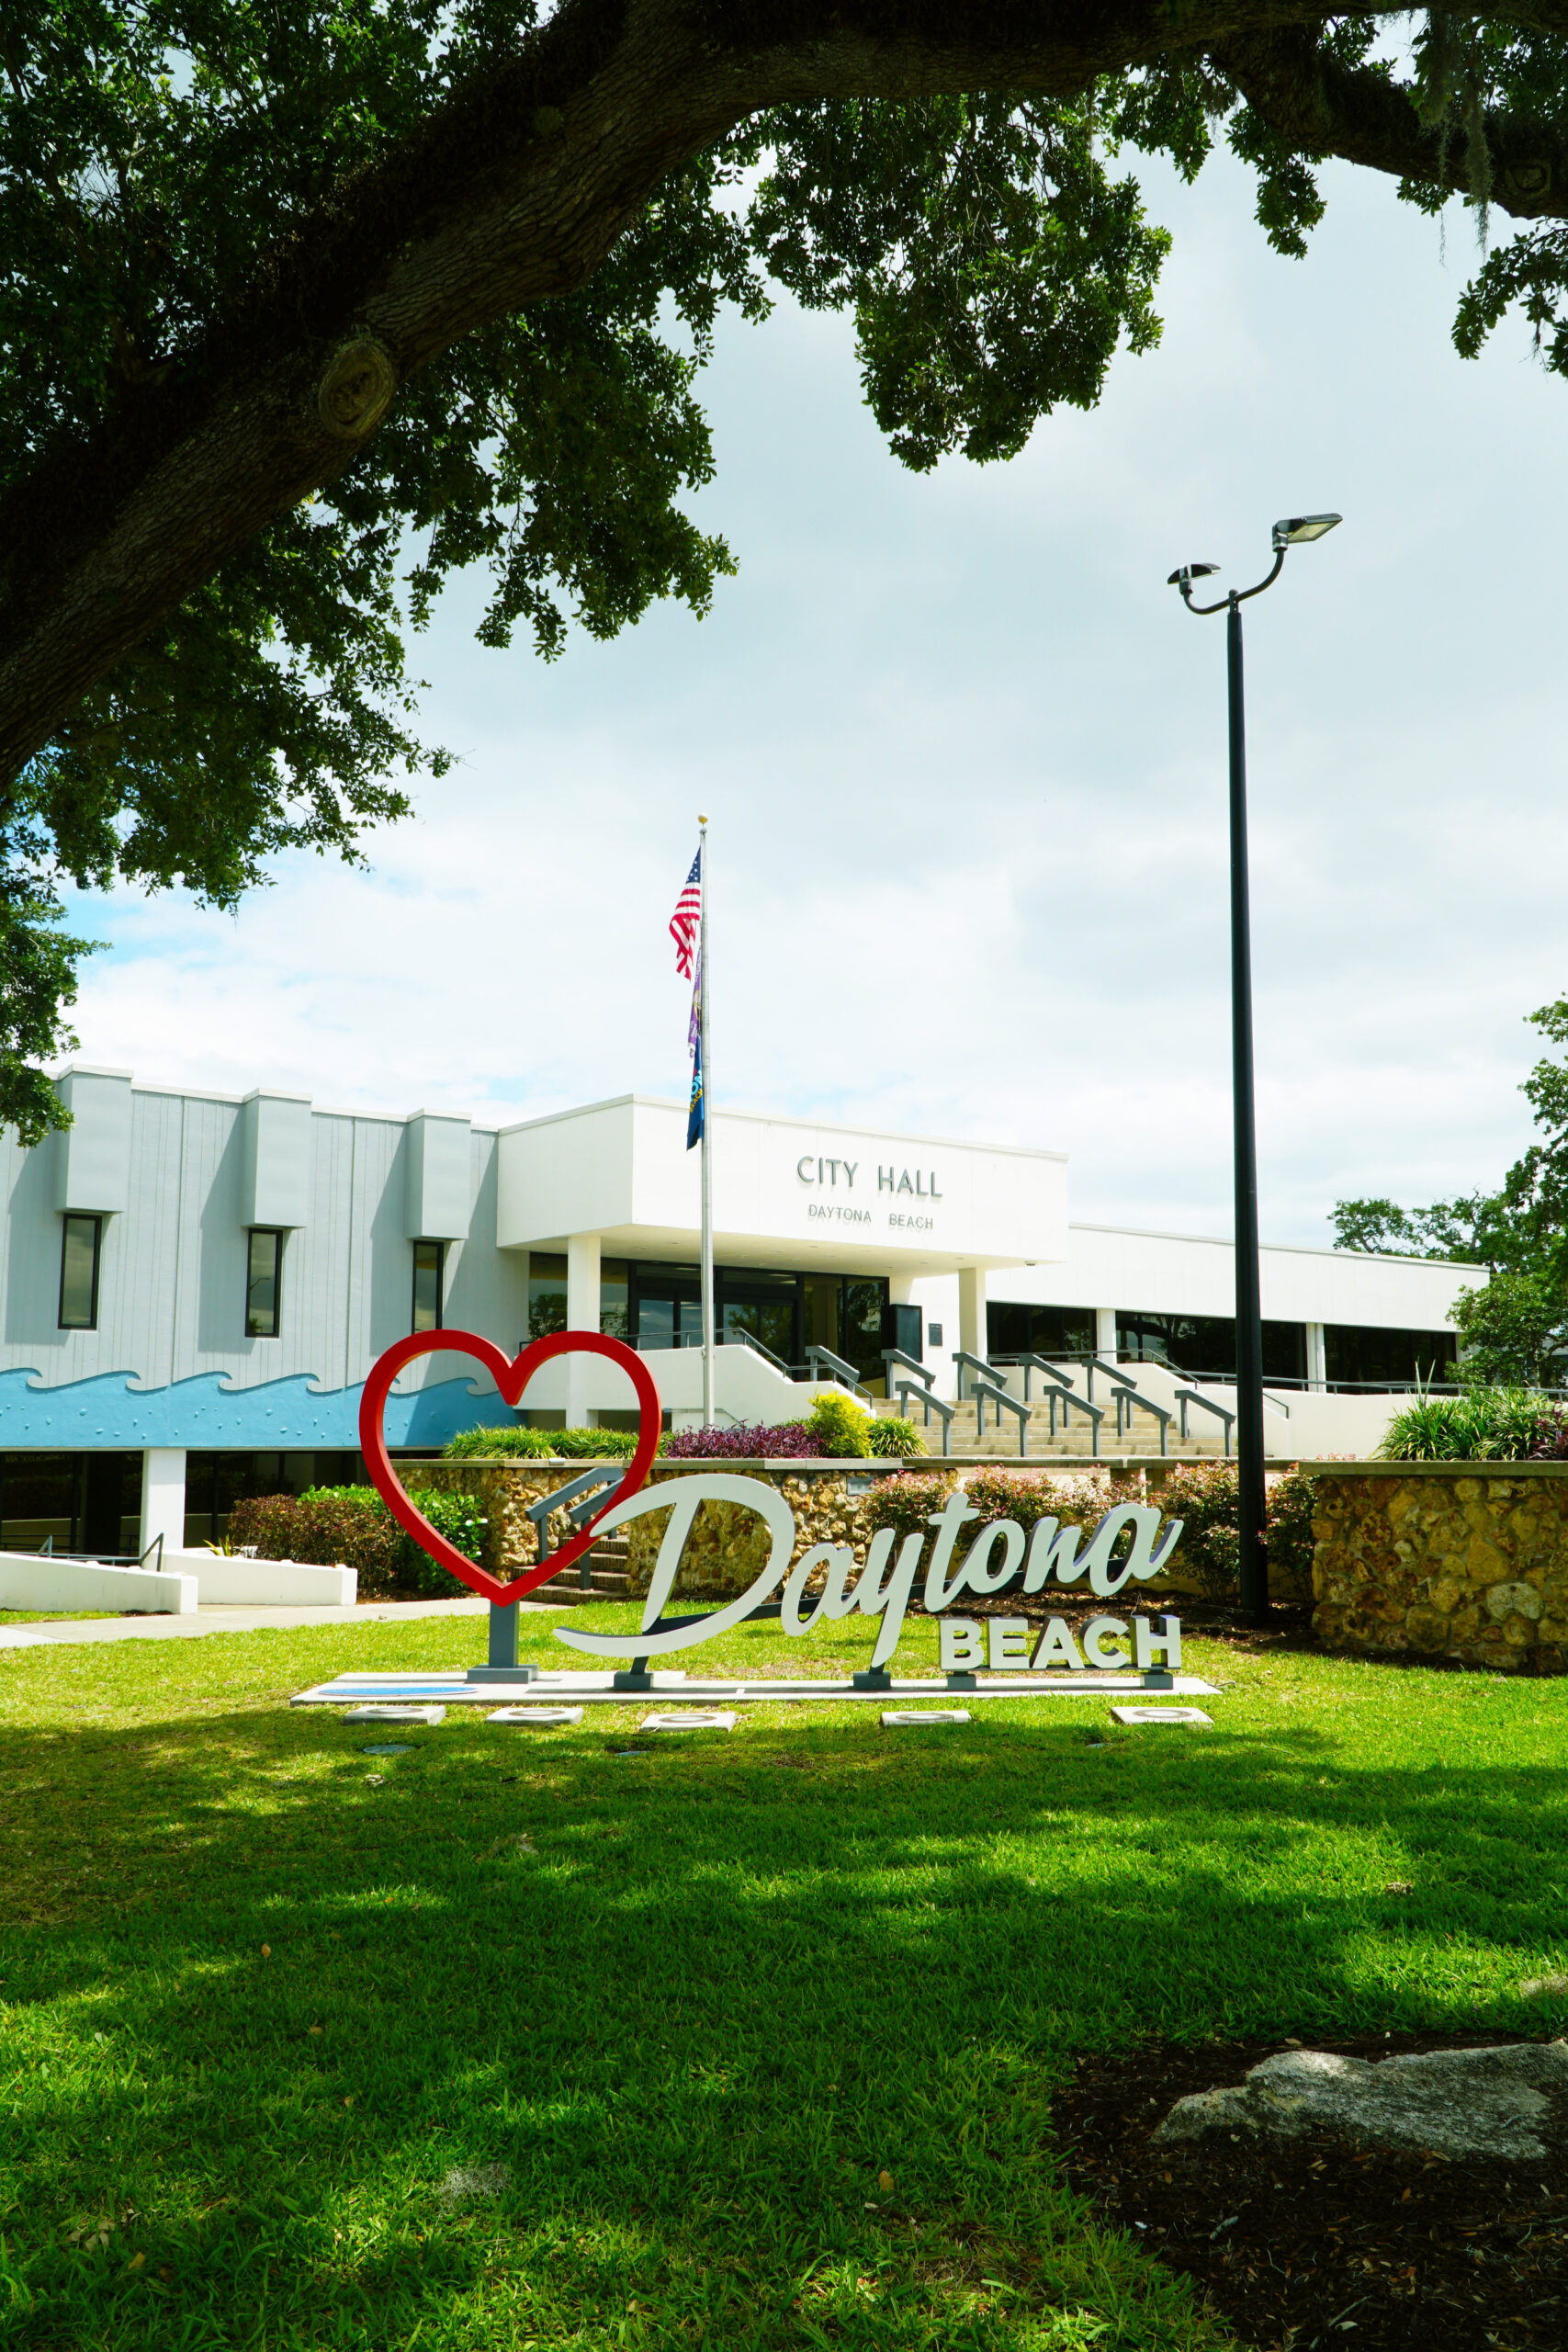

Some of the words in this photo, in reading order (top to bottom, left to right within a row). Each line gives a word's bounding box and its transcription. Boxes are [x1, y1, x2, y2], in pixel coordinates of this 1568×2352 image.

[797, 1156, 859, 1188] CITY
[878, 1166, 943, 1198] HALL
[808, 1204, 872, 1223] DAYTONA
[889, 1213, 933, 1229] BEACH
[553, 1474, 1183, 1668] Daytona
[941, 1614, 1181, 1669] BEACH
